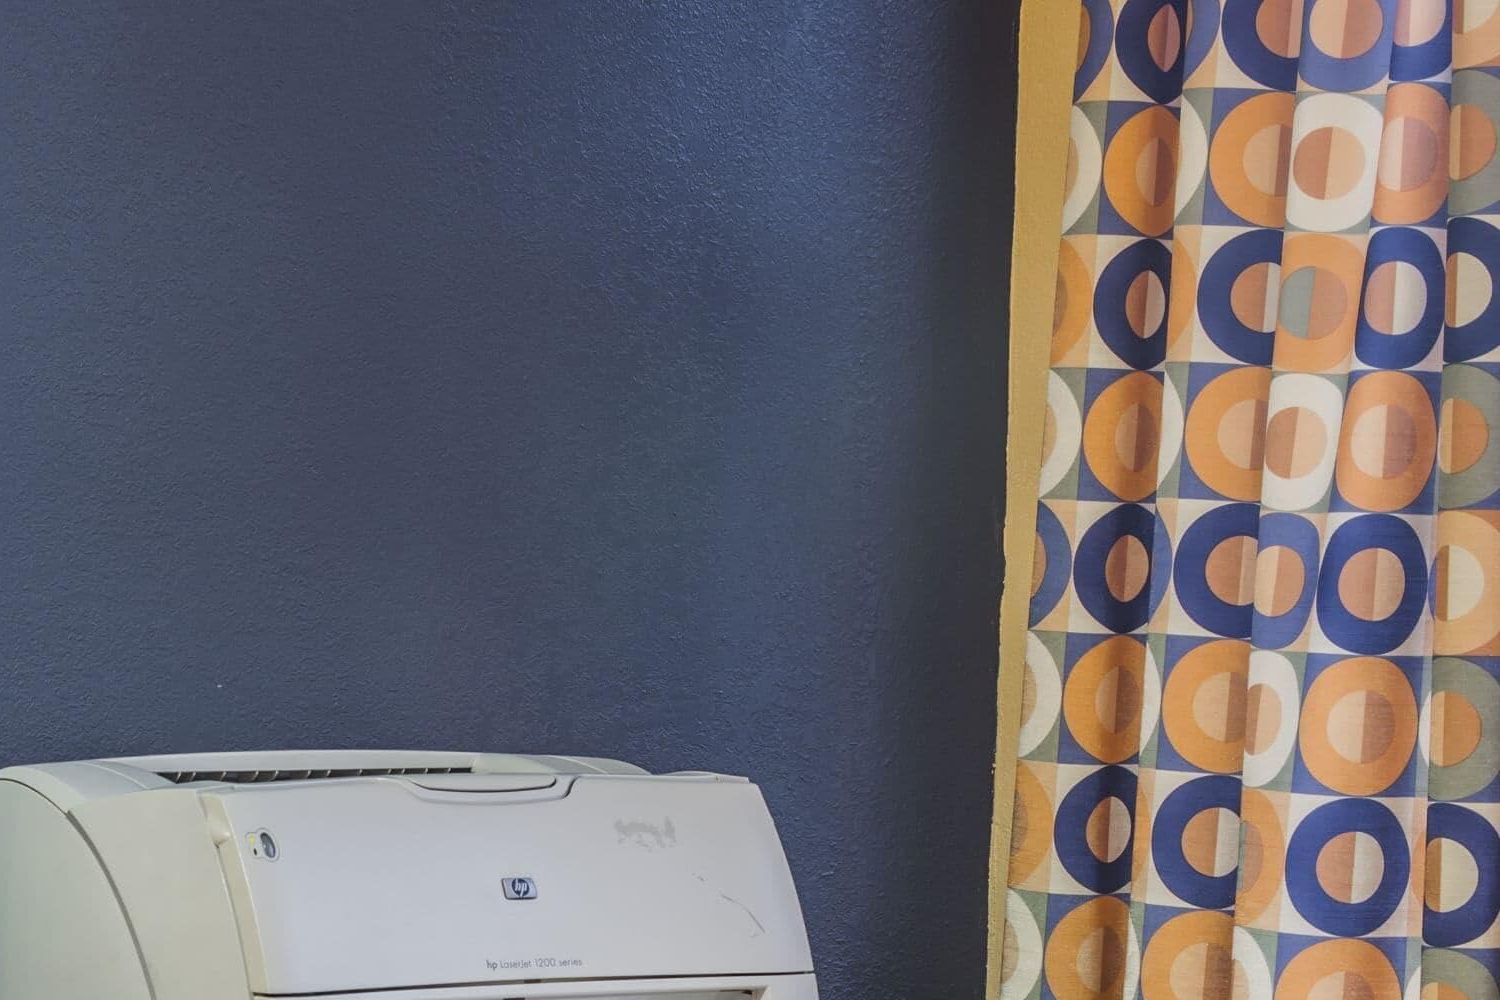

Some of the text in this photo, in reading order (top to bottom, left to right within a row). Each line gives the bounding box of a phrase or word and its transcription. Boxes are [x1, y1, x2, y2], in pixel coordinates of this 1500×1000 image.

[513, 878, 529, 898] hp
[486, 960, 498, 971] hp
[534, 958, 556, 968] 1200
[558, 958, 583, 967] series
